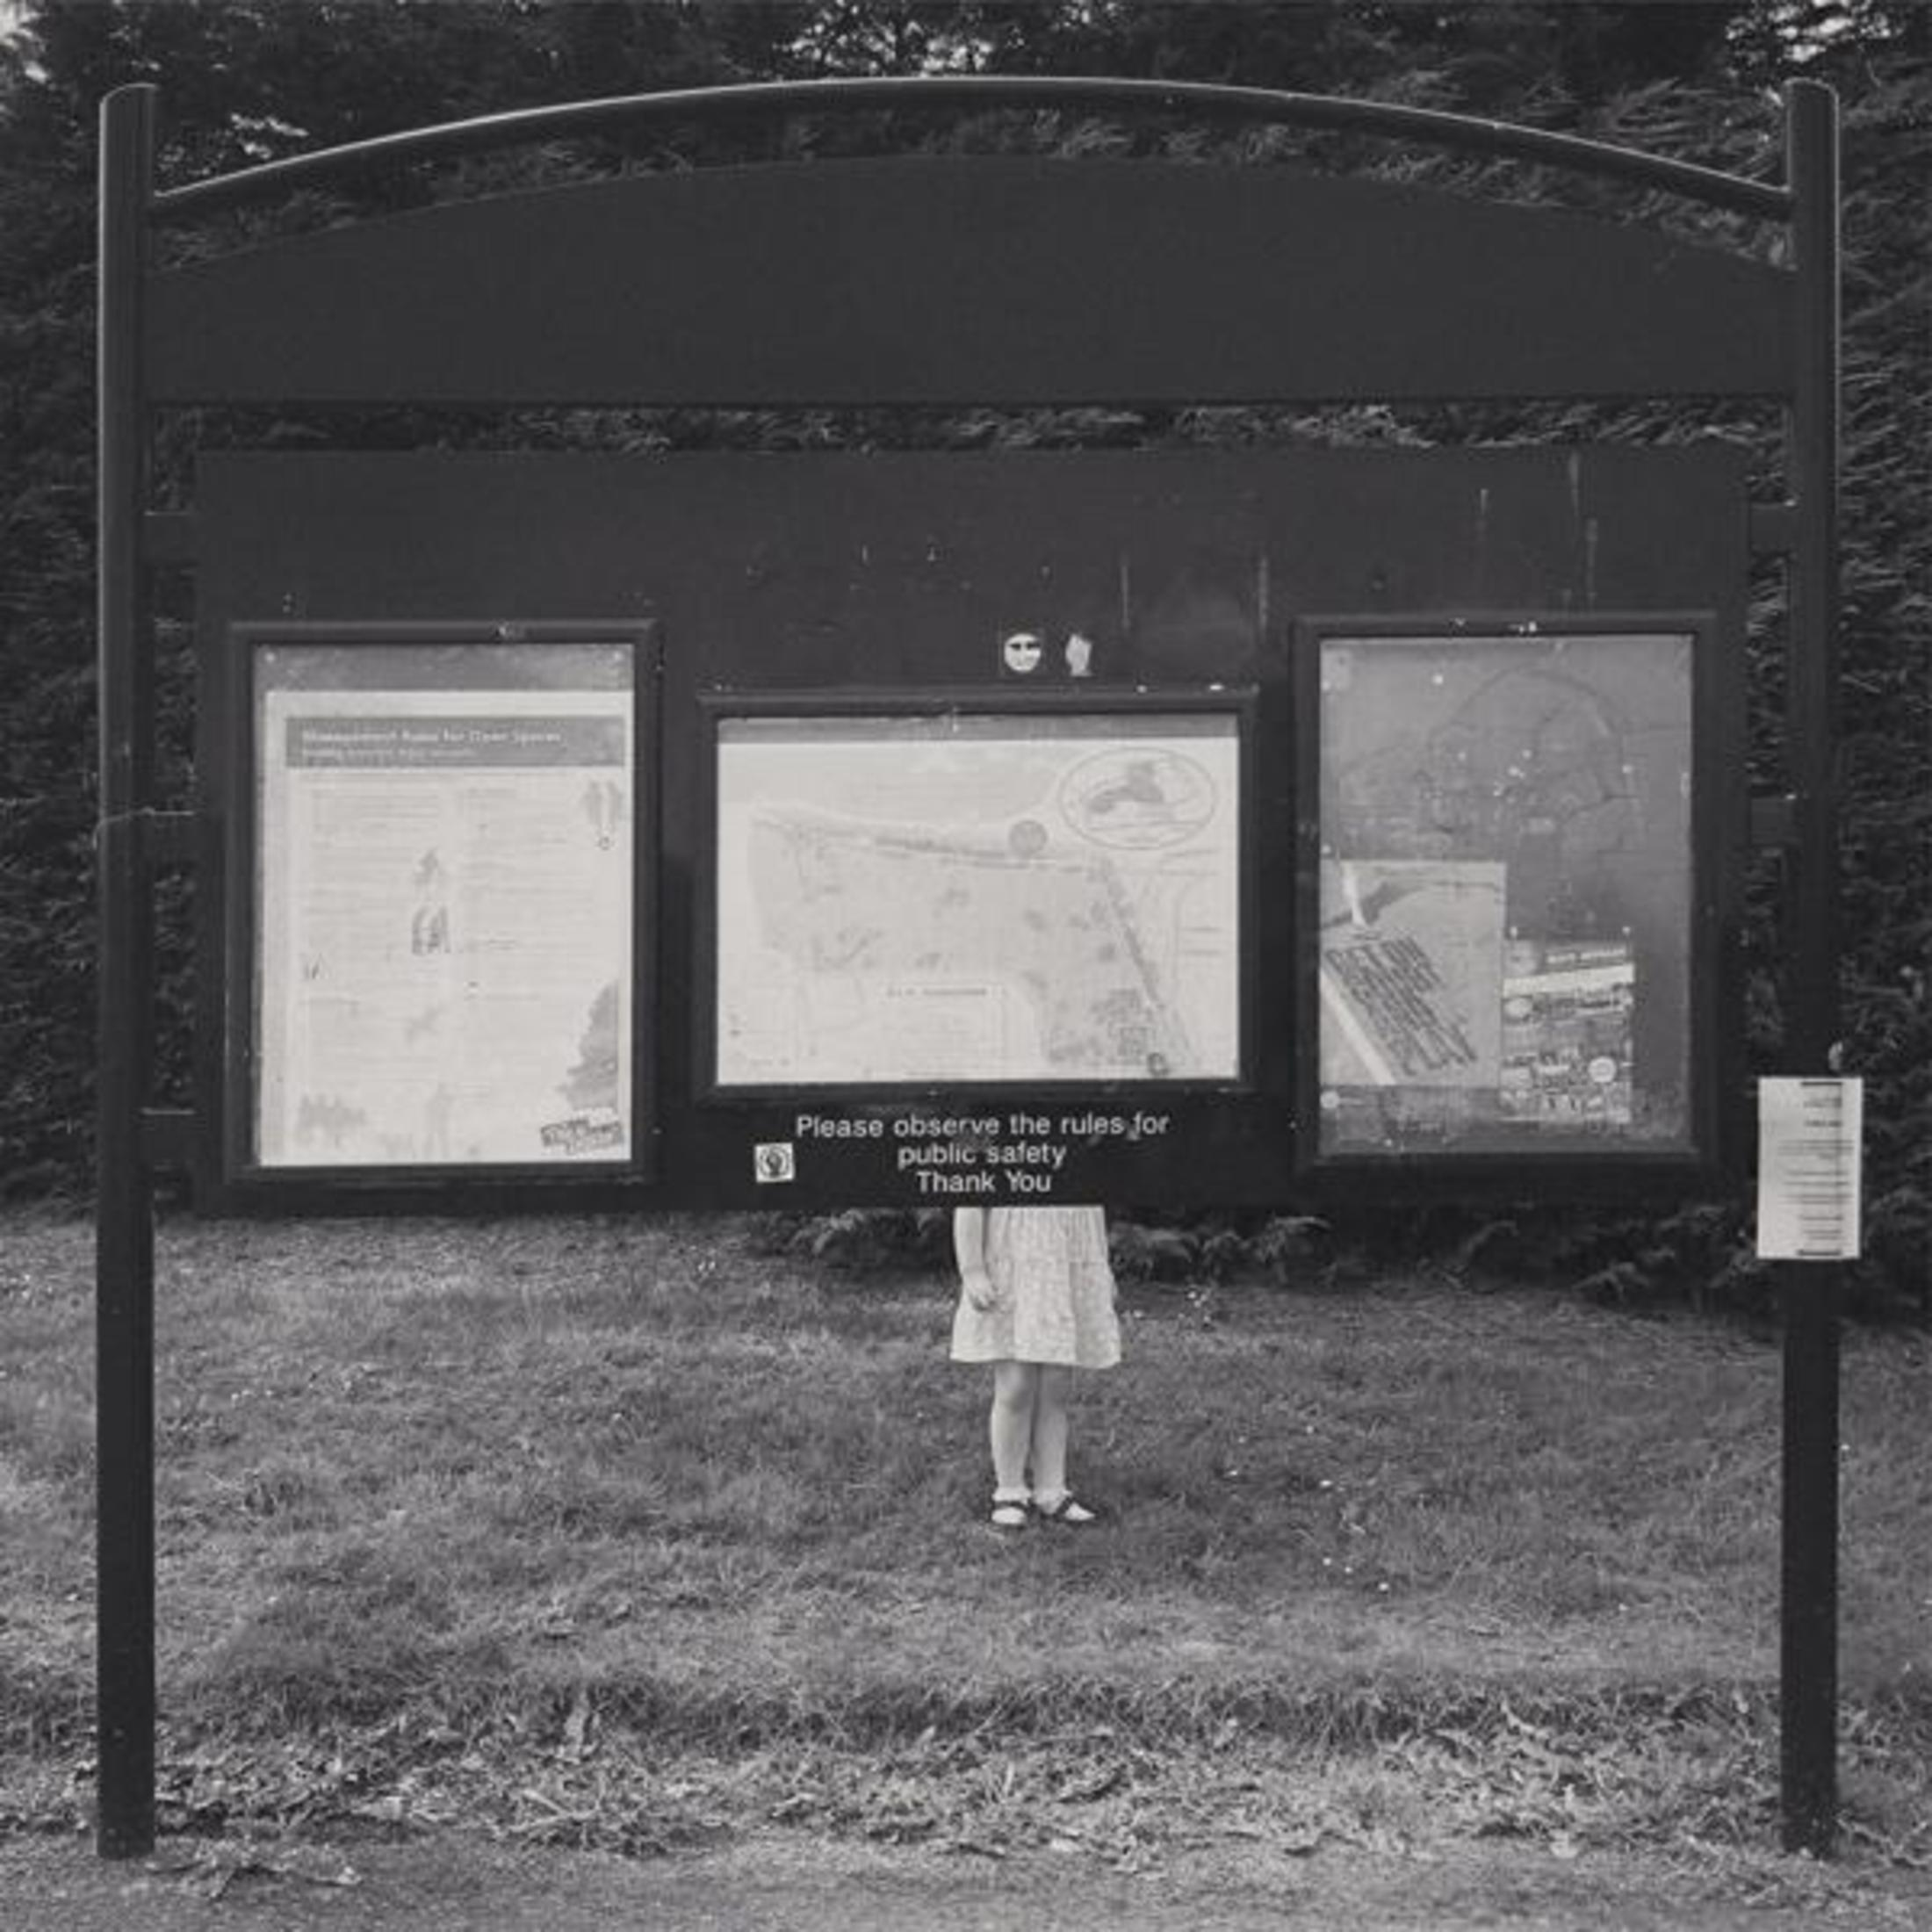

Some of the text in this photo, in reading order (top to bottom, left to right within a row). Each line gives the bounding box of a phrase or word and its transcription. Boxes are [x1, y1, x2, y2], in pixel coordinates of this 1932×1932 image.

[797, 1112, 1170, 1137] Please observe the rules for
[898, 1143, 1067, 1170] public safety
[916, 1170, 1051, 1193] Thank You
